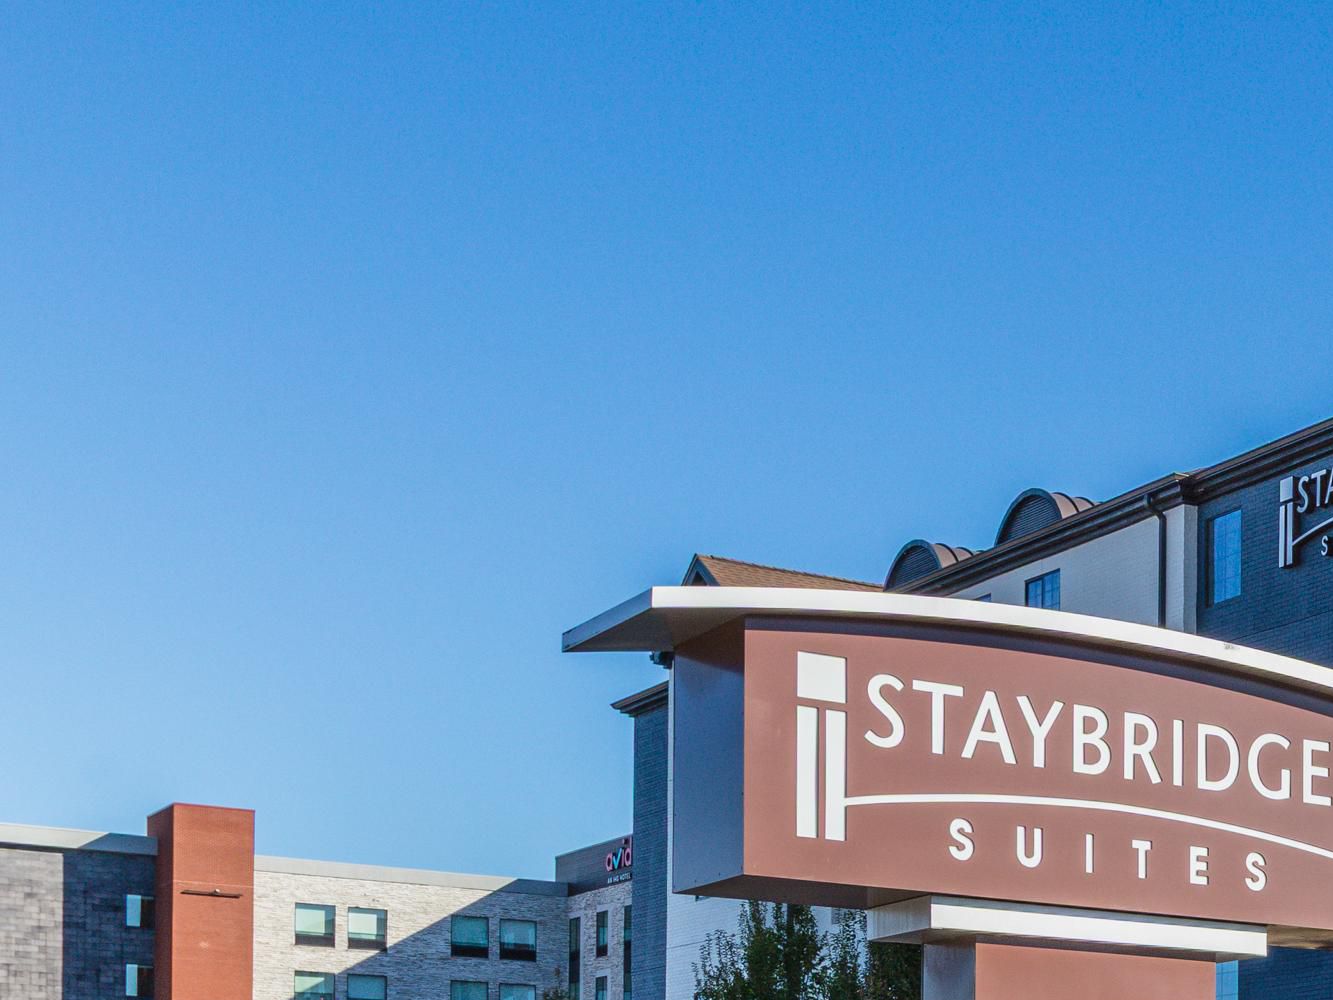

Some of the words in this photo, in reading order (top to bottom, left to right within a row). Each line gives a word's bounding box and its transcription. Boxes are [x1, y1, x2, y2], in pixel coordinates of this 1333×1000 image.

[863, 672, 1333, 807] STAYBRIDGE
[605, 836, 632, 872] avid
[947, 817, 1268, 893] SUITES
